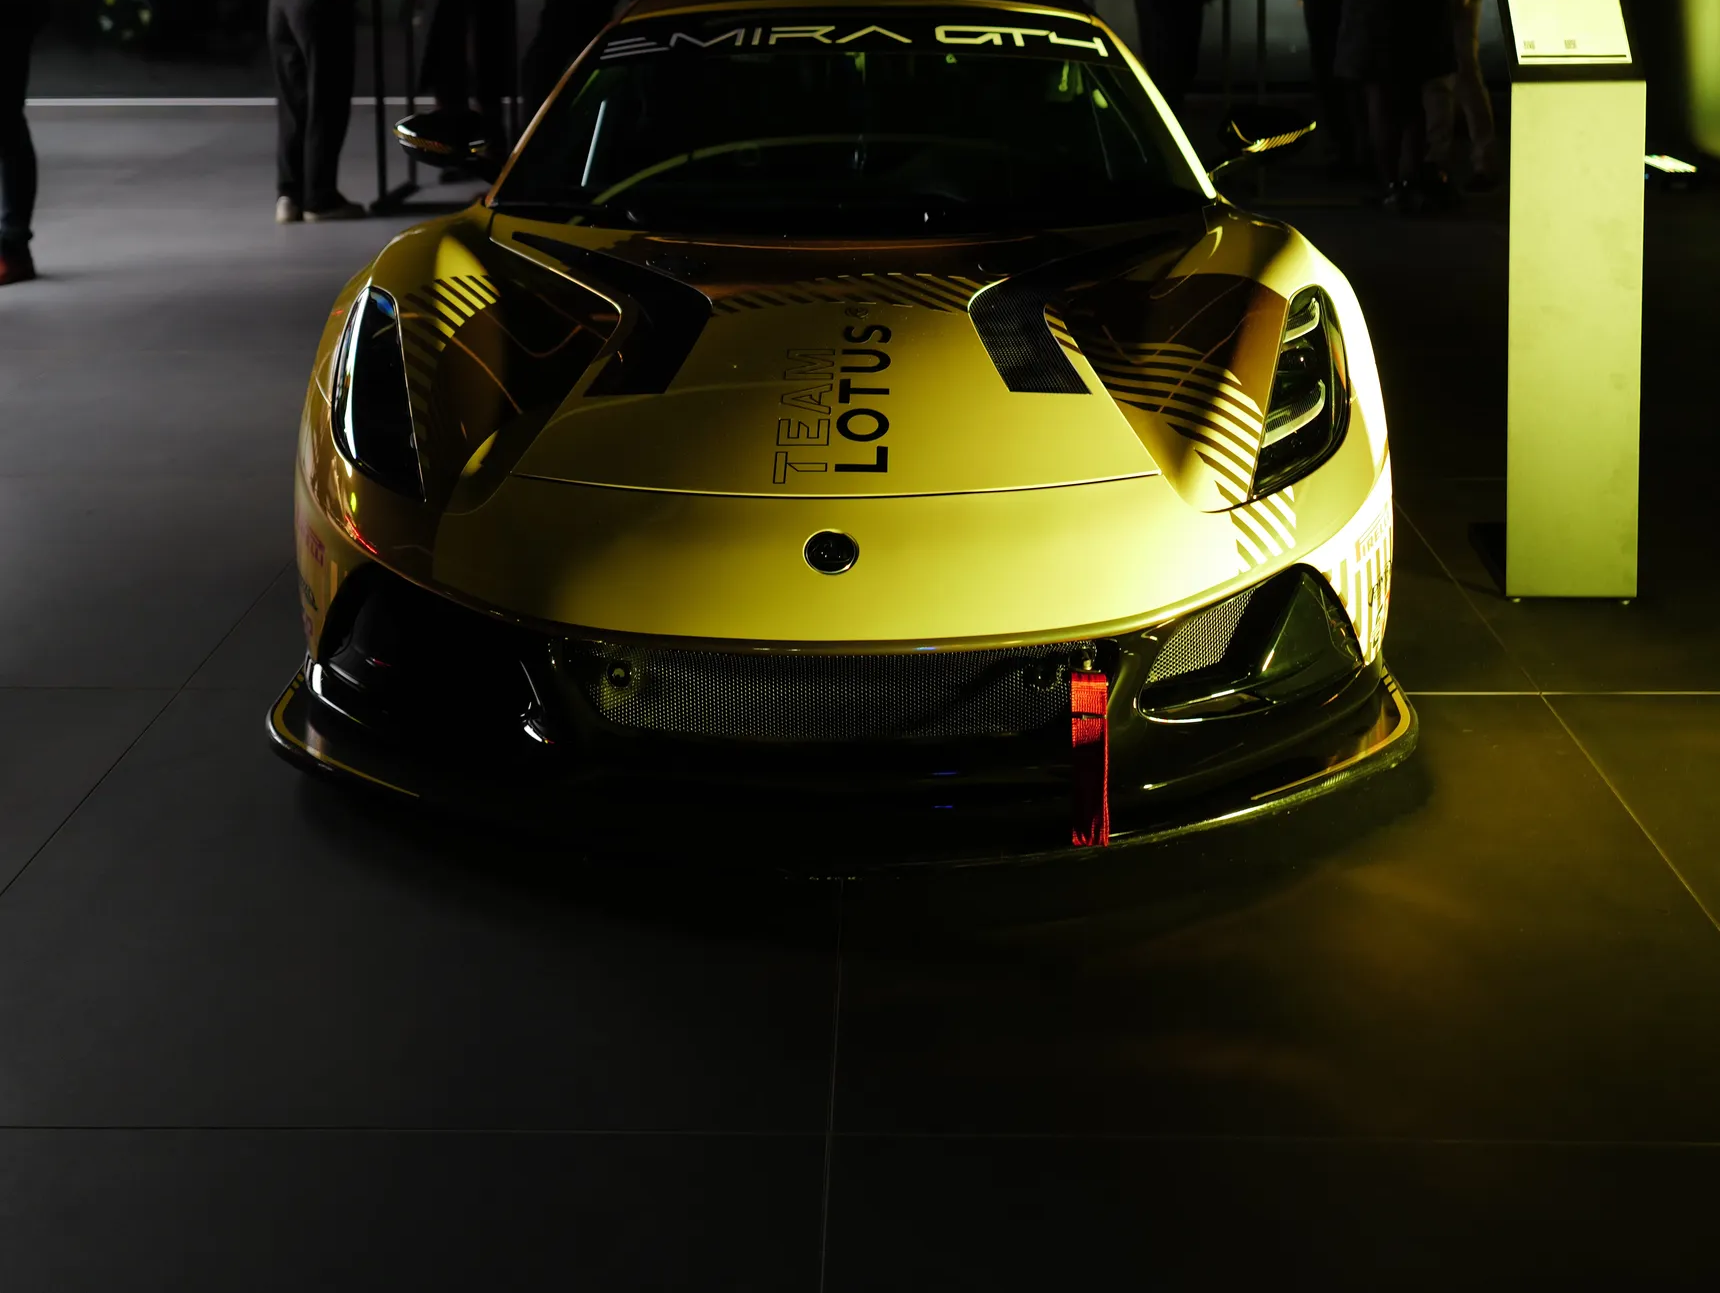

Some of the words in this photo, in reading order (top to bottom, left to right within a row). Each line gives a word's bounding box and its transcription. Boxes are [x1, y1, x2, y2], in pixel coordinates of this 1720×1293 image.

[600, 25, 912, 60] EMIRA
[935, 25, 1108, 58] GT4
[772, 348, 836, 484] TEAM
[834, 324, 892, 474] LOTUS
